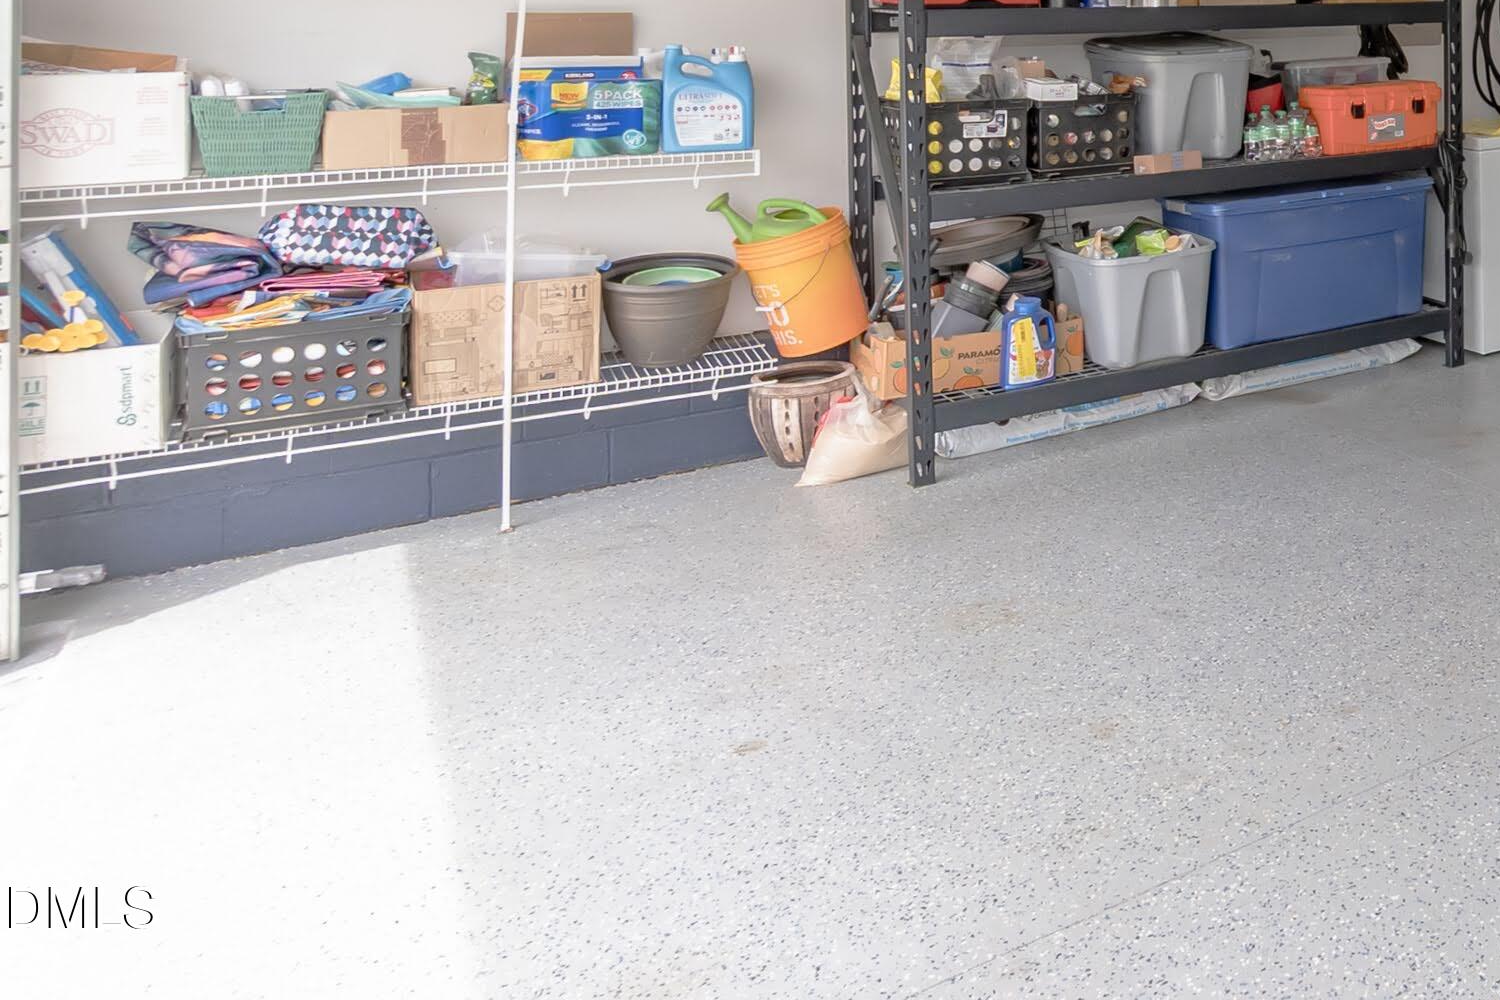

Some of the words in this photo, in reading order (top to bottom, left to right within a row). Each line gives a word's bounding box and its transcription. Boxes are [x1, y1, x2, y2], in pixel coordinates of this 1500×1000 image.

[605, 88, 642, 99] PACK
[20, 124, 106, 143] SWAD
[772, 329, 803, 346] HIS.
[958, 348, 1001, 359] PARAMO
